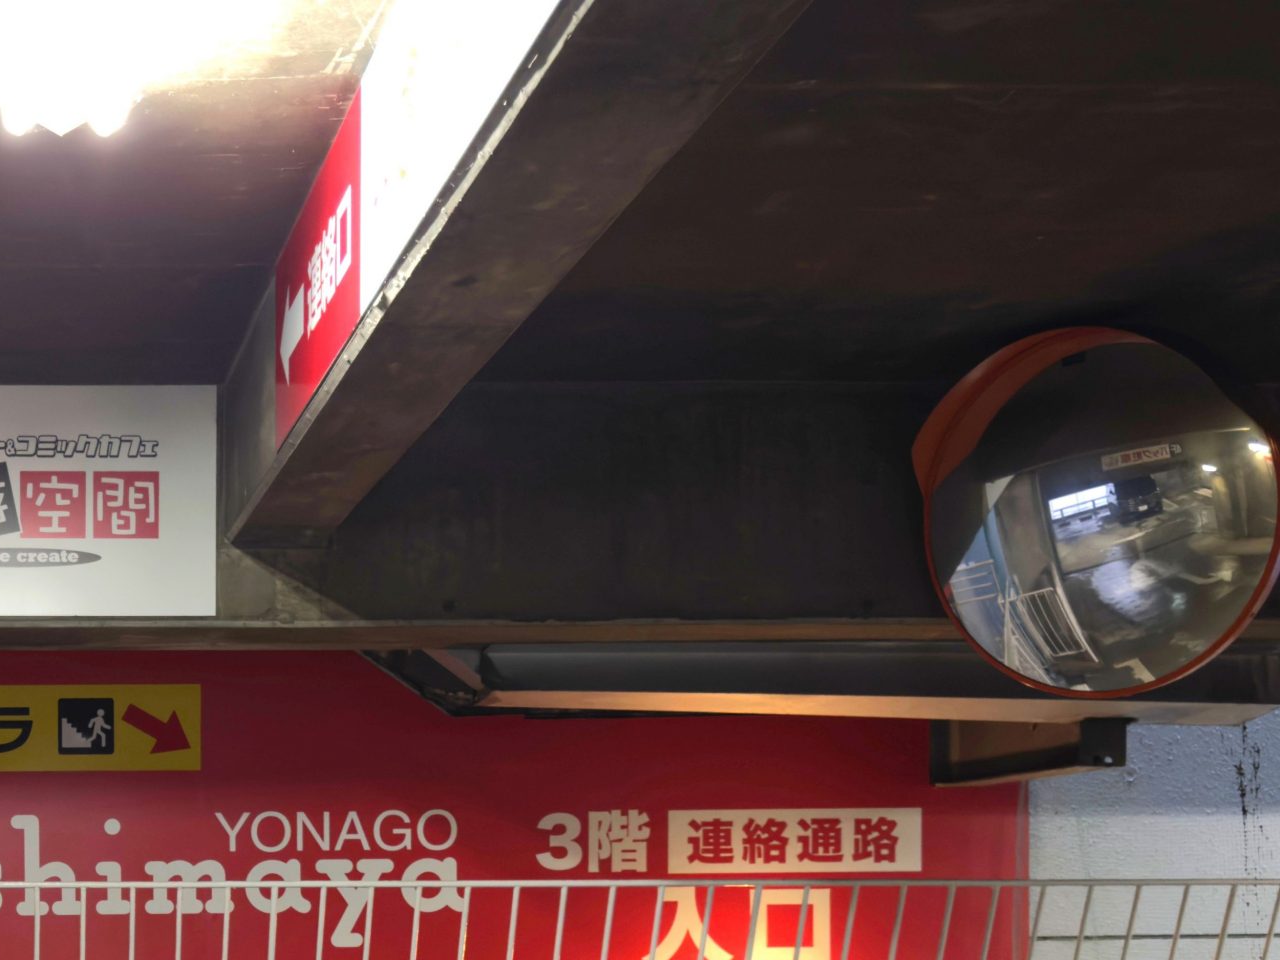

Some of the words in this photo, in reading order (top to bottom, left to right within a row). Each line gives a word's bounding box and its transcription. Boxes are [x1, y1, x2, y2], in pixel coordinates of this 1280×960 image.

[307, 184, 352, 341] 連絡口
[17, 549, 79, 562] create
[214, 808, 459, 853] YONAGO
[535, 809, 651, 874] 3階
[686, 816, 900, 865] 連絡通路
